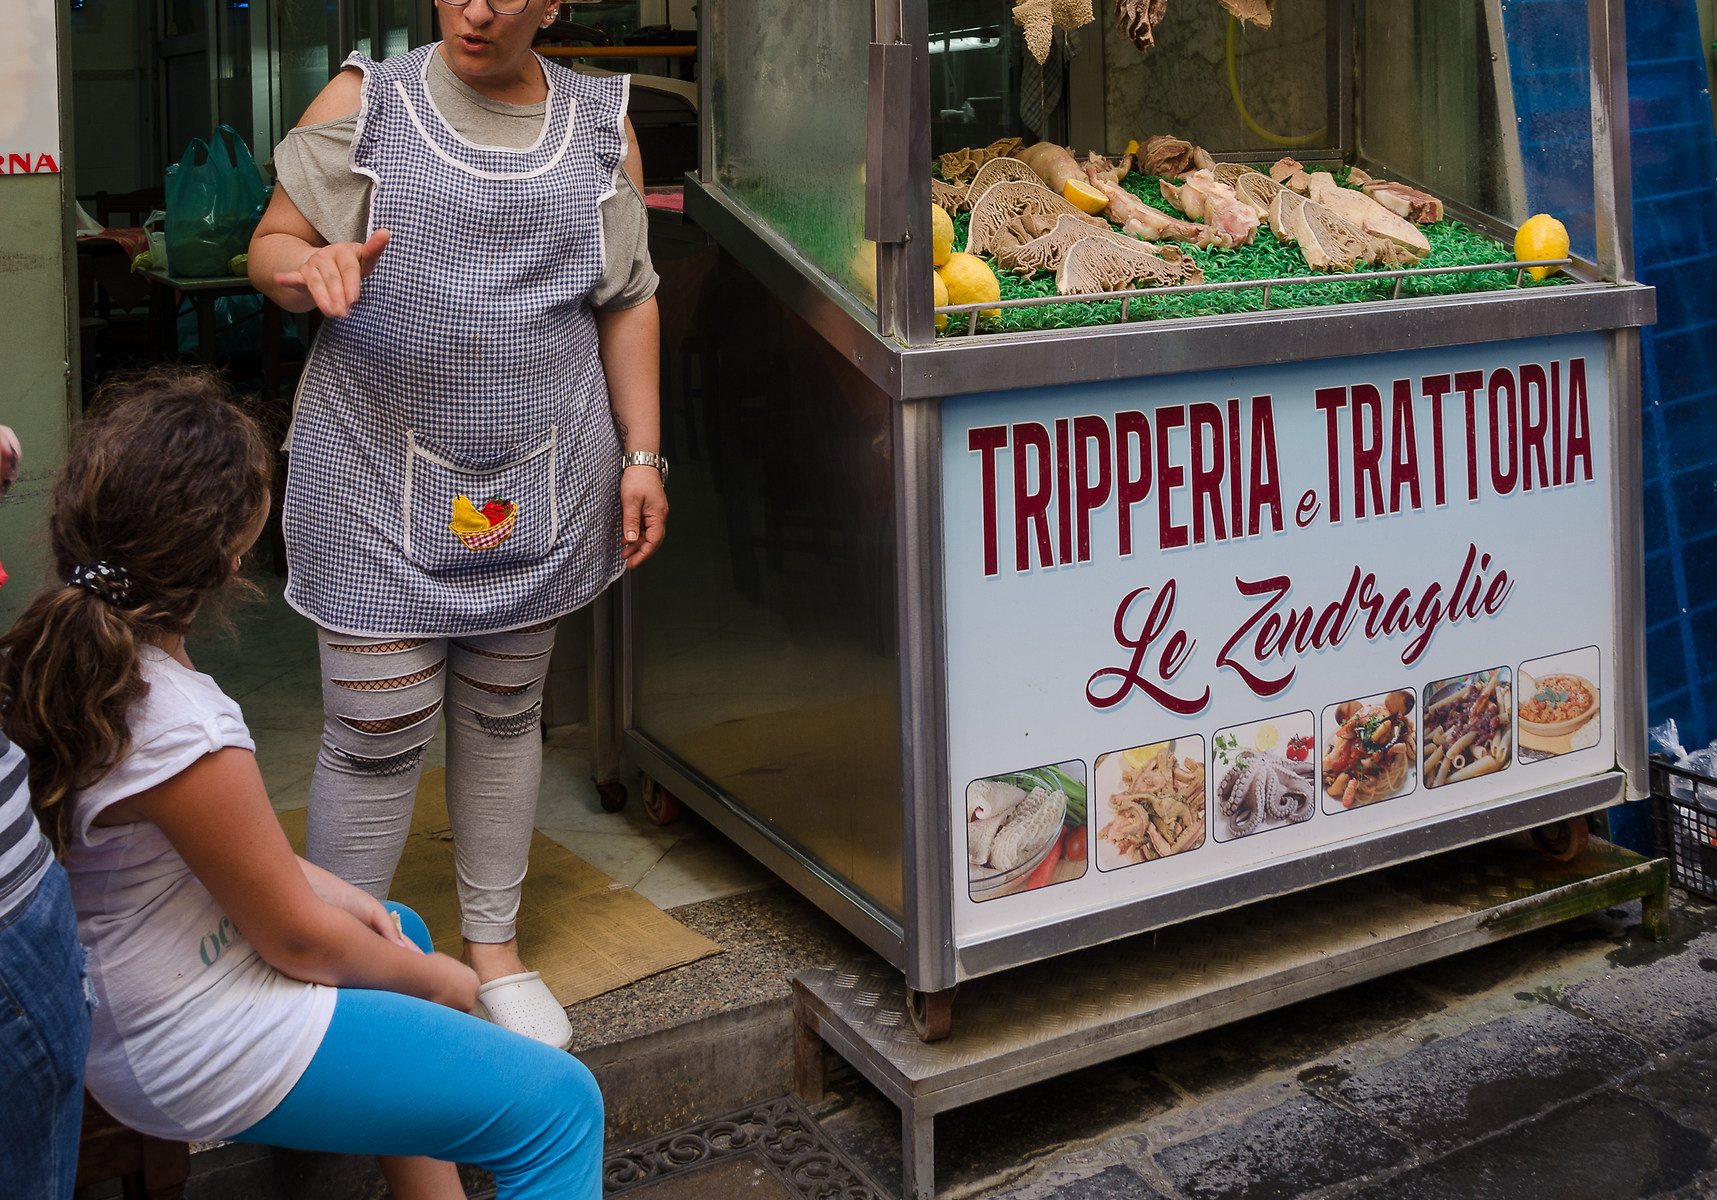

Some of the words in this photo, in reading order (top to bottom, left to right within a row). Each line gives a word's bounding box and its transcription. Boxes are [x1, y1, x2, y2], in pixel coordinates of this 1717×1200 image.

[966, 394, 1285, 577] TRIPPERIA
[1295, 487, 1321, 528] e
[1314, 356, 1595, 524] TRATTORIA
[1086, 578, 1210, 715] Le
[1216, 542, 1514, 697] Zendraglie
